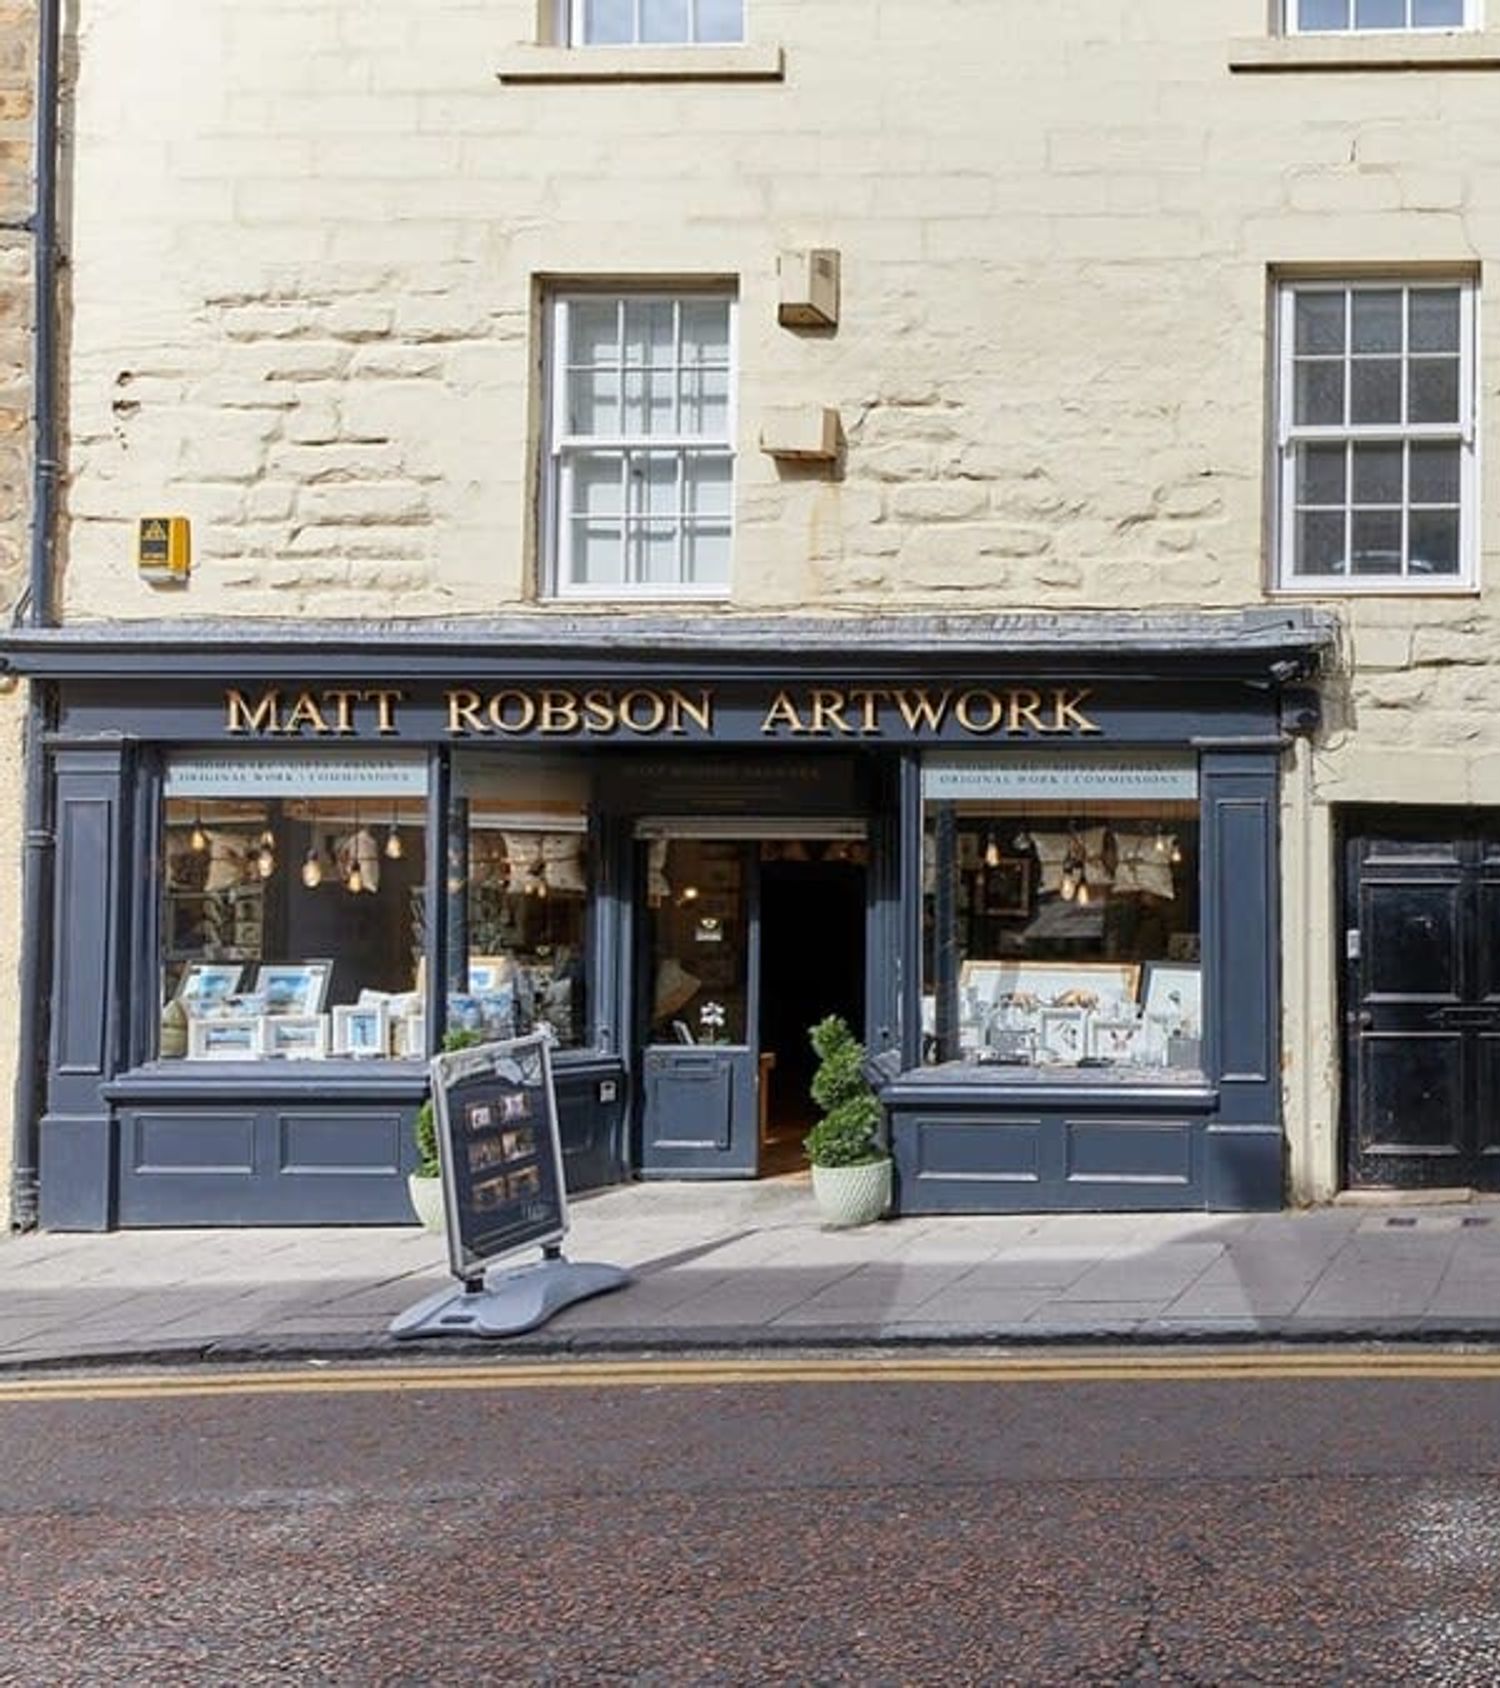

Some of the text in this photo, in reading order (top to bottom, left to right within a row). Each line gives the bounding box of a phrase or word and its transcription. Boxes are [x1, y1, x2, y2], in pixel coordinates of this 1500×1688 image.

[224, 688, 1101, 733] MATT ROBSON ARTWORK
[254, 772, 293, 782] WORK
[939, 774, 1010, 785] ORIGINAL
[1017, 774, 1059, 785] WORK
[1073, 774, 1180, 785] COMMISSIONS
